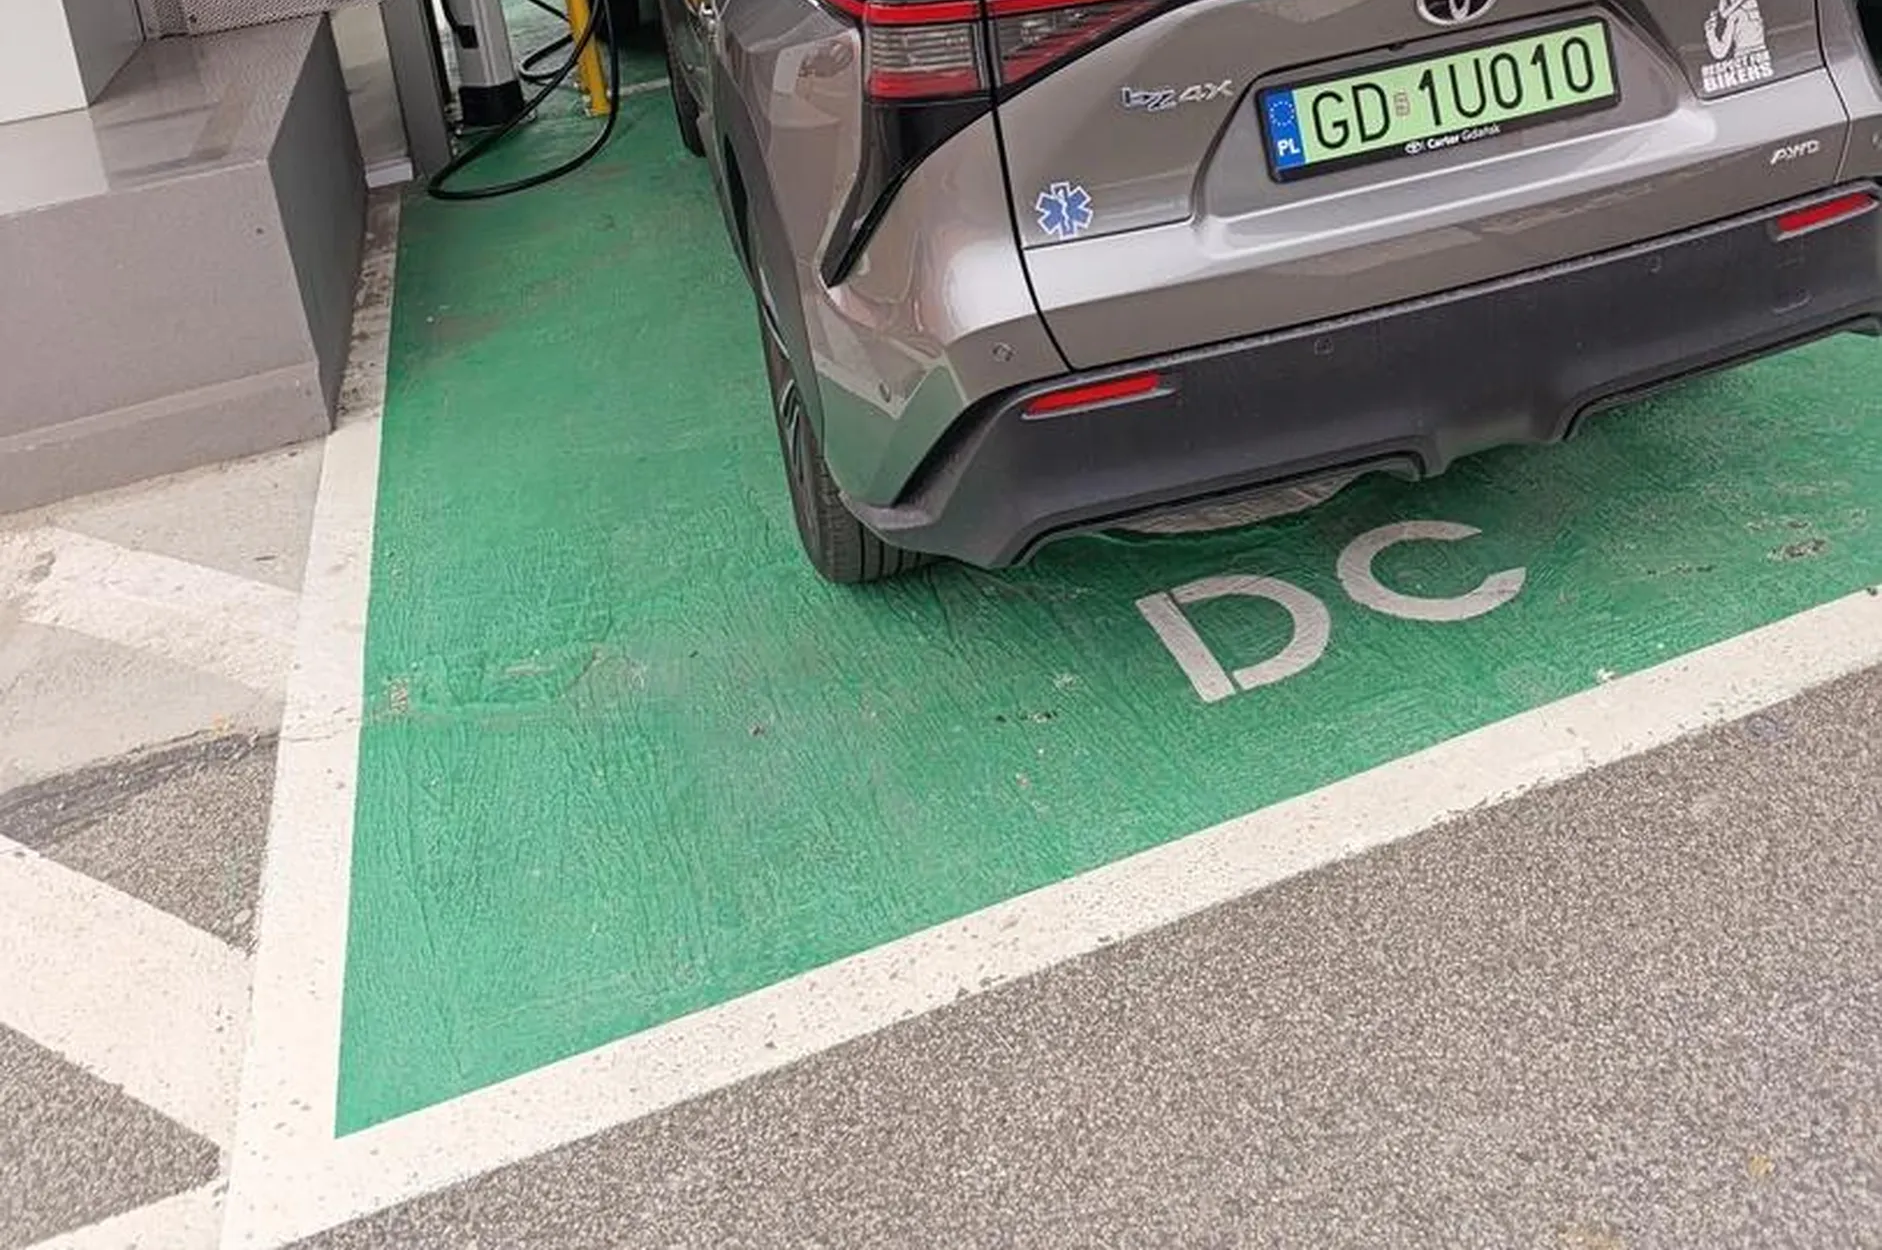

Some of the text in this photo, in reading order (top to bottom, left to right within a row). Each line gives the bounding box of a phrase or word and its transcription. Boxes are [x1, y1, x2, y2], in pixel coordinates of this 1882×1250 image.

[1703, 62, 1774, 93] BIKERS
[1311, 36, 1595, 150] GD 1U010
[1277, 138, 1301, 156] PL
[1426, 134, 1460, 150] Carter
[1770, 139, 1821, 165] AWD
[1135, 520, 1527, 703] DC
